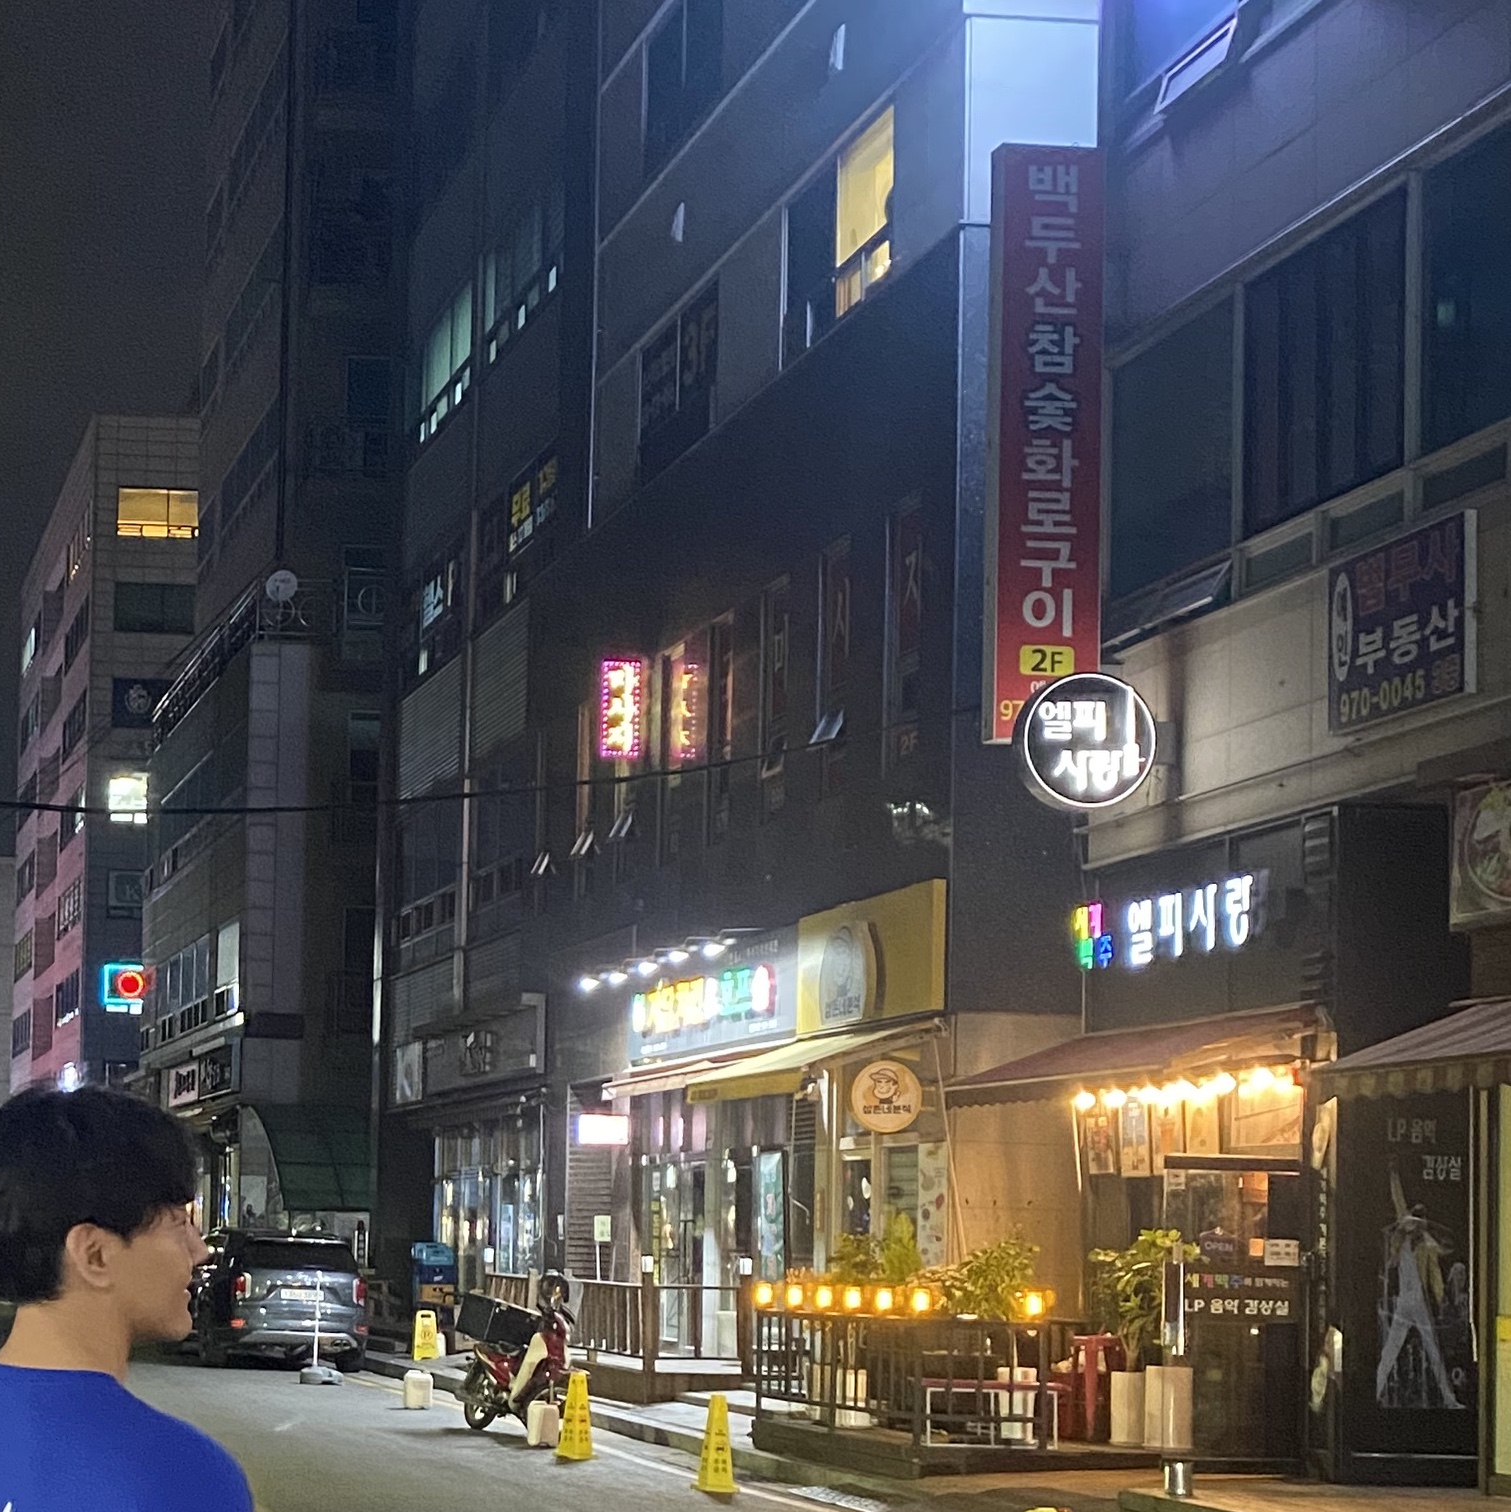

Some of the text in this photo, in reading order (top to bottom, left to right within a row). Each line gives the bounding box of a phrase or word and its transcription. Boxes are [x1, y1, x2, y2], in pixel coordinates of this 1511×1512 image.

[1020, 162, 1082, 638] 백두산참숯화로구이
[1354, 597, 1461, 676] 부동산
[1030, 648, 1064, 673] 2F
[1340, 669, 1426, 724] 970-0045
[1039, 701, 1107, 742] 엘피
[1053, 749, 1124, 792] 사랑
[1128, 874, 1254, 967] 엘피사랑
[1387, 1118, 1407, 1142] LP
[1422, 1155, 1462, 1181] 감상실
[1204, 1241, 1234, 1252] OPEN
[1185, 1298, 1290, 1316] LP 음악 감상실
